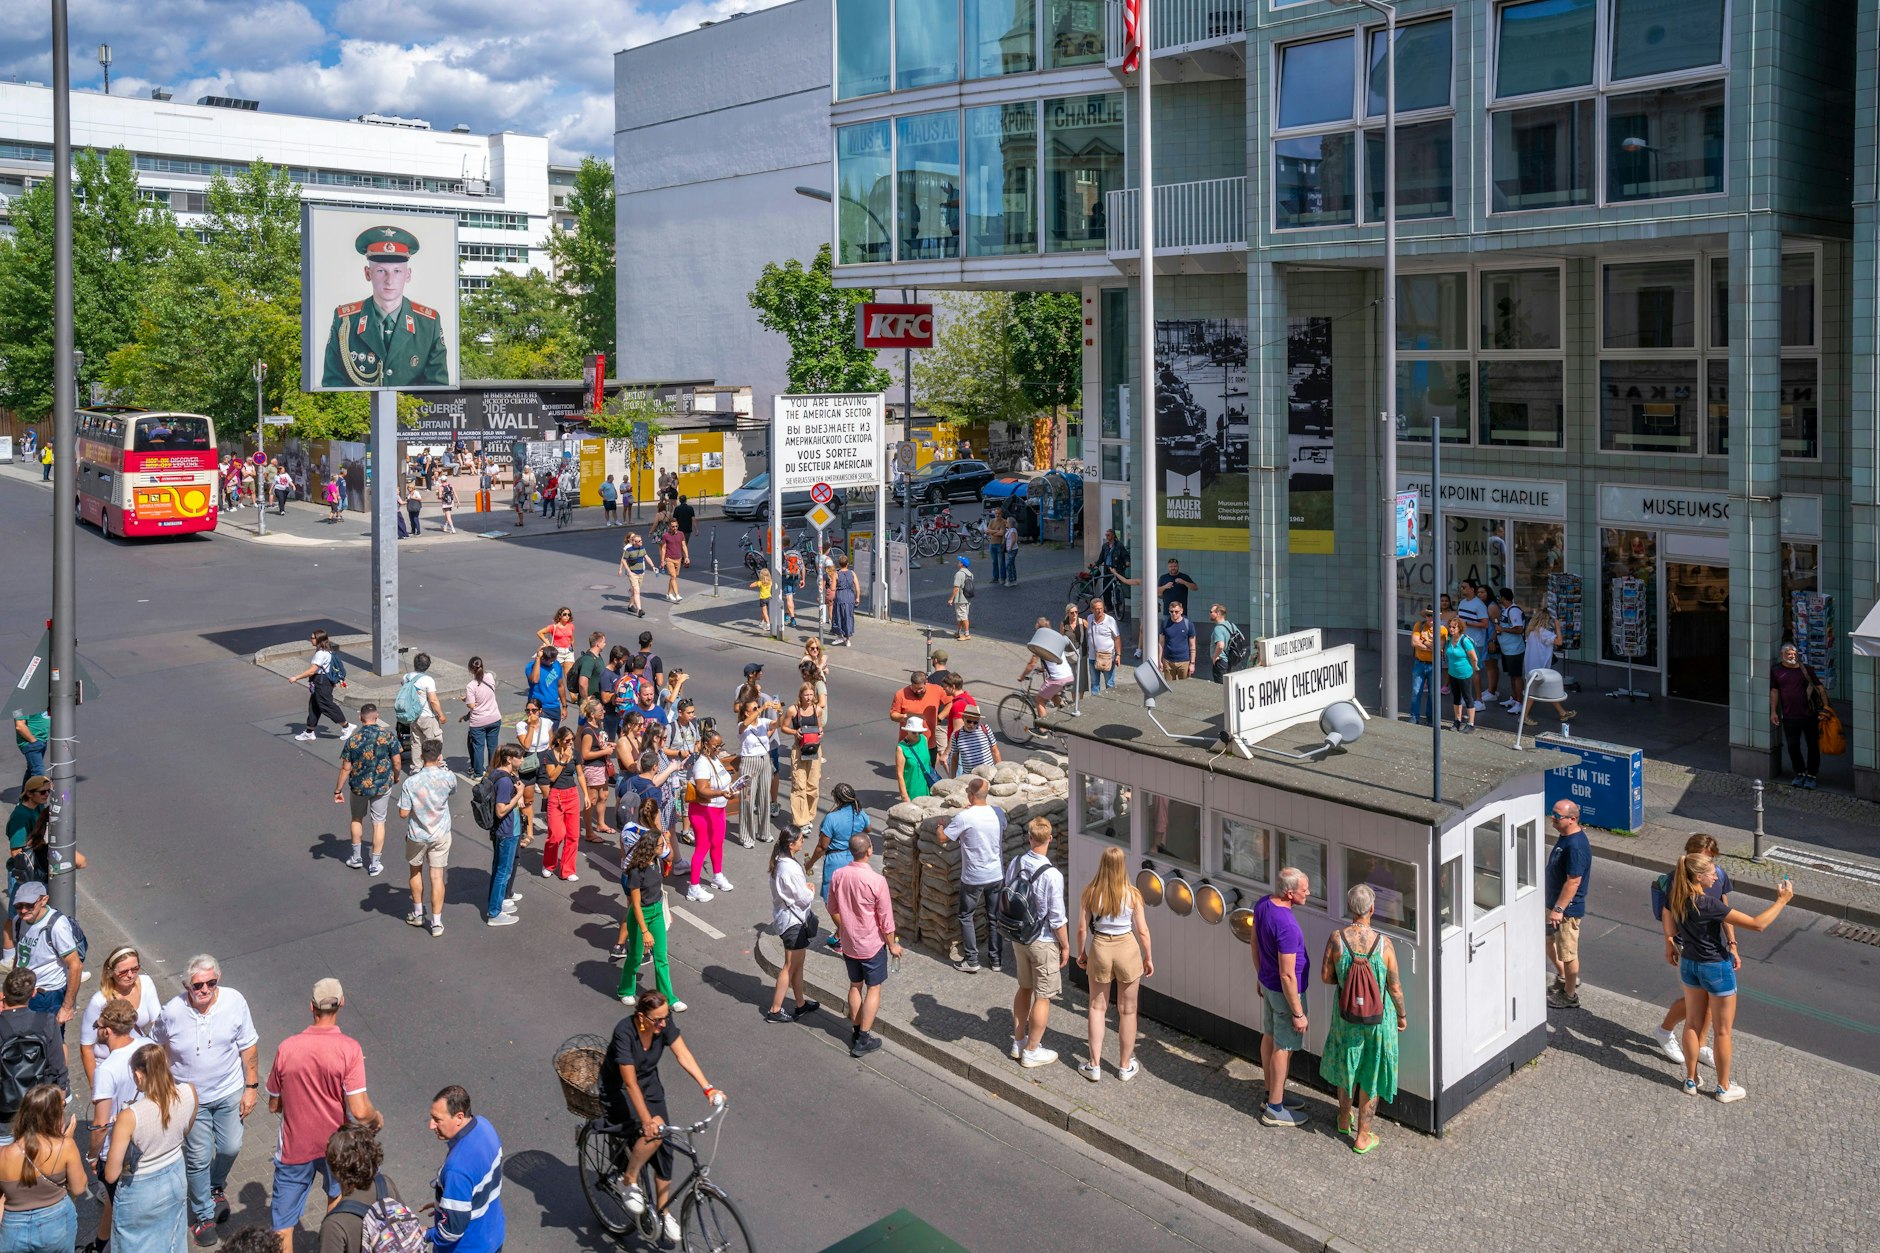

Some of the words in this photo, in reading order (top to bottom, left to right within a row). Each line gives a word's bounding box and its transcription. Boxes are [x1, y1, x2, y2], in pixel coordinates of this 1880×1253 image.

[850, 128, 888, 153] MUSEU
[905, 121, 940, 144] HAUS
[973, 110, 1034, 136] CHECKPOIN
[1054, 102, 1123, 128] CHARLIE
[867, 314, 932, 338] KFC
[420, 404, 463, 413] GUERRE
[791, 398, 807, 408] YOU
[813, 398, 828, 407] ARE
[834, 397, 867, 406] LEAVING
[786, 410, 799, 419] THE
[803, 409, 841, 419] AMERICAN
[845, 408, 872, 418] SECTOR
[417, 421, 450, 429] URTAIN
[488, 413, 538, 429] WALL
[787, 426, 800, 434] ВЫ
[805, 423, 855, 434] ВЫЕЗЖАЕТЕ
[860, 422, 870, 431] ИЗ
[785, 435, 842, 446] АМЕРИКАНСКОГО
[844, 434, 872, 443] СЕКТОРА
[798, 449, 821, 460] VOUS
[826, 448, 857, 458] SORTEZ
[786, 463, 796, 472] DU
[798, 461, 830, 472] SECTEUR
[1085, 466, 1097, 477] 45
[793, 476, 815, 484] VERLASSEN
[825, 474, 857, 482] AMERIKANISCHEN
[1408, 483, 1486, 502] CHEKPOINT
[1492, 489, 1549, 506] CHARLIE
[1167, 499, 1200, 510] MAUER
[1167, 510, 1201, 519] MUSEUM
[1274, 642, 1288, 657] ALLIED
[1290, 636, 1314, 654] CHECKPOINT
[1260, 677, 1288, 707] ARMY
[1292, 660, 1348, 698] CHECKPOINT
[1553, 766, 1573, 779] LIFE
[1577, 768, 1587, 781] IN
[1591, 771, 1611, 786] THE
[1572, 783, 1592, 798] GDR
